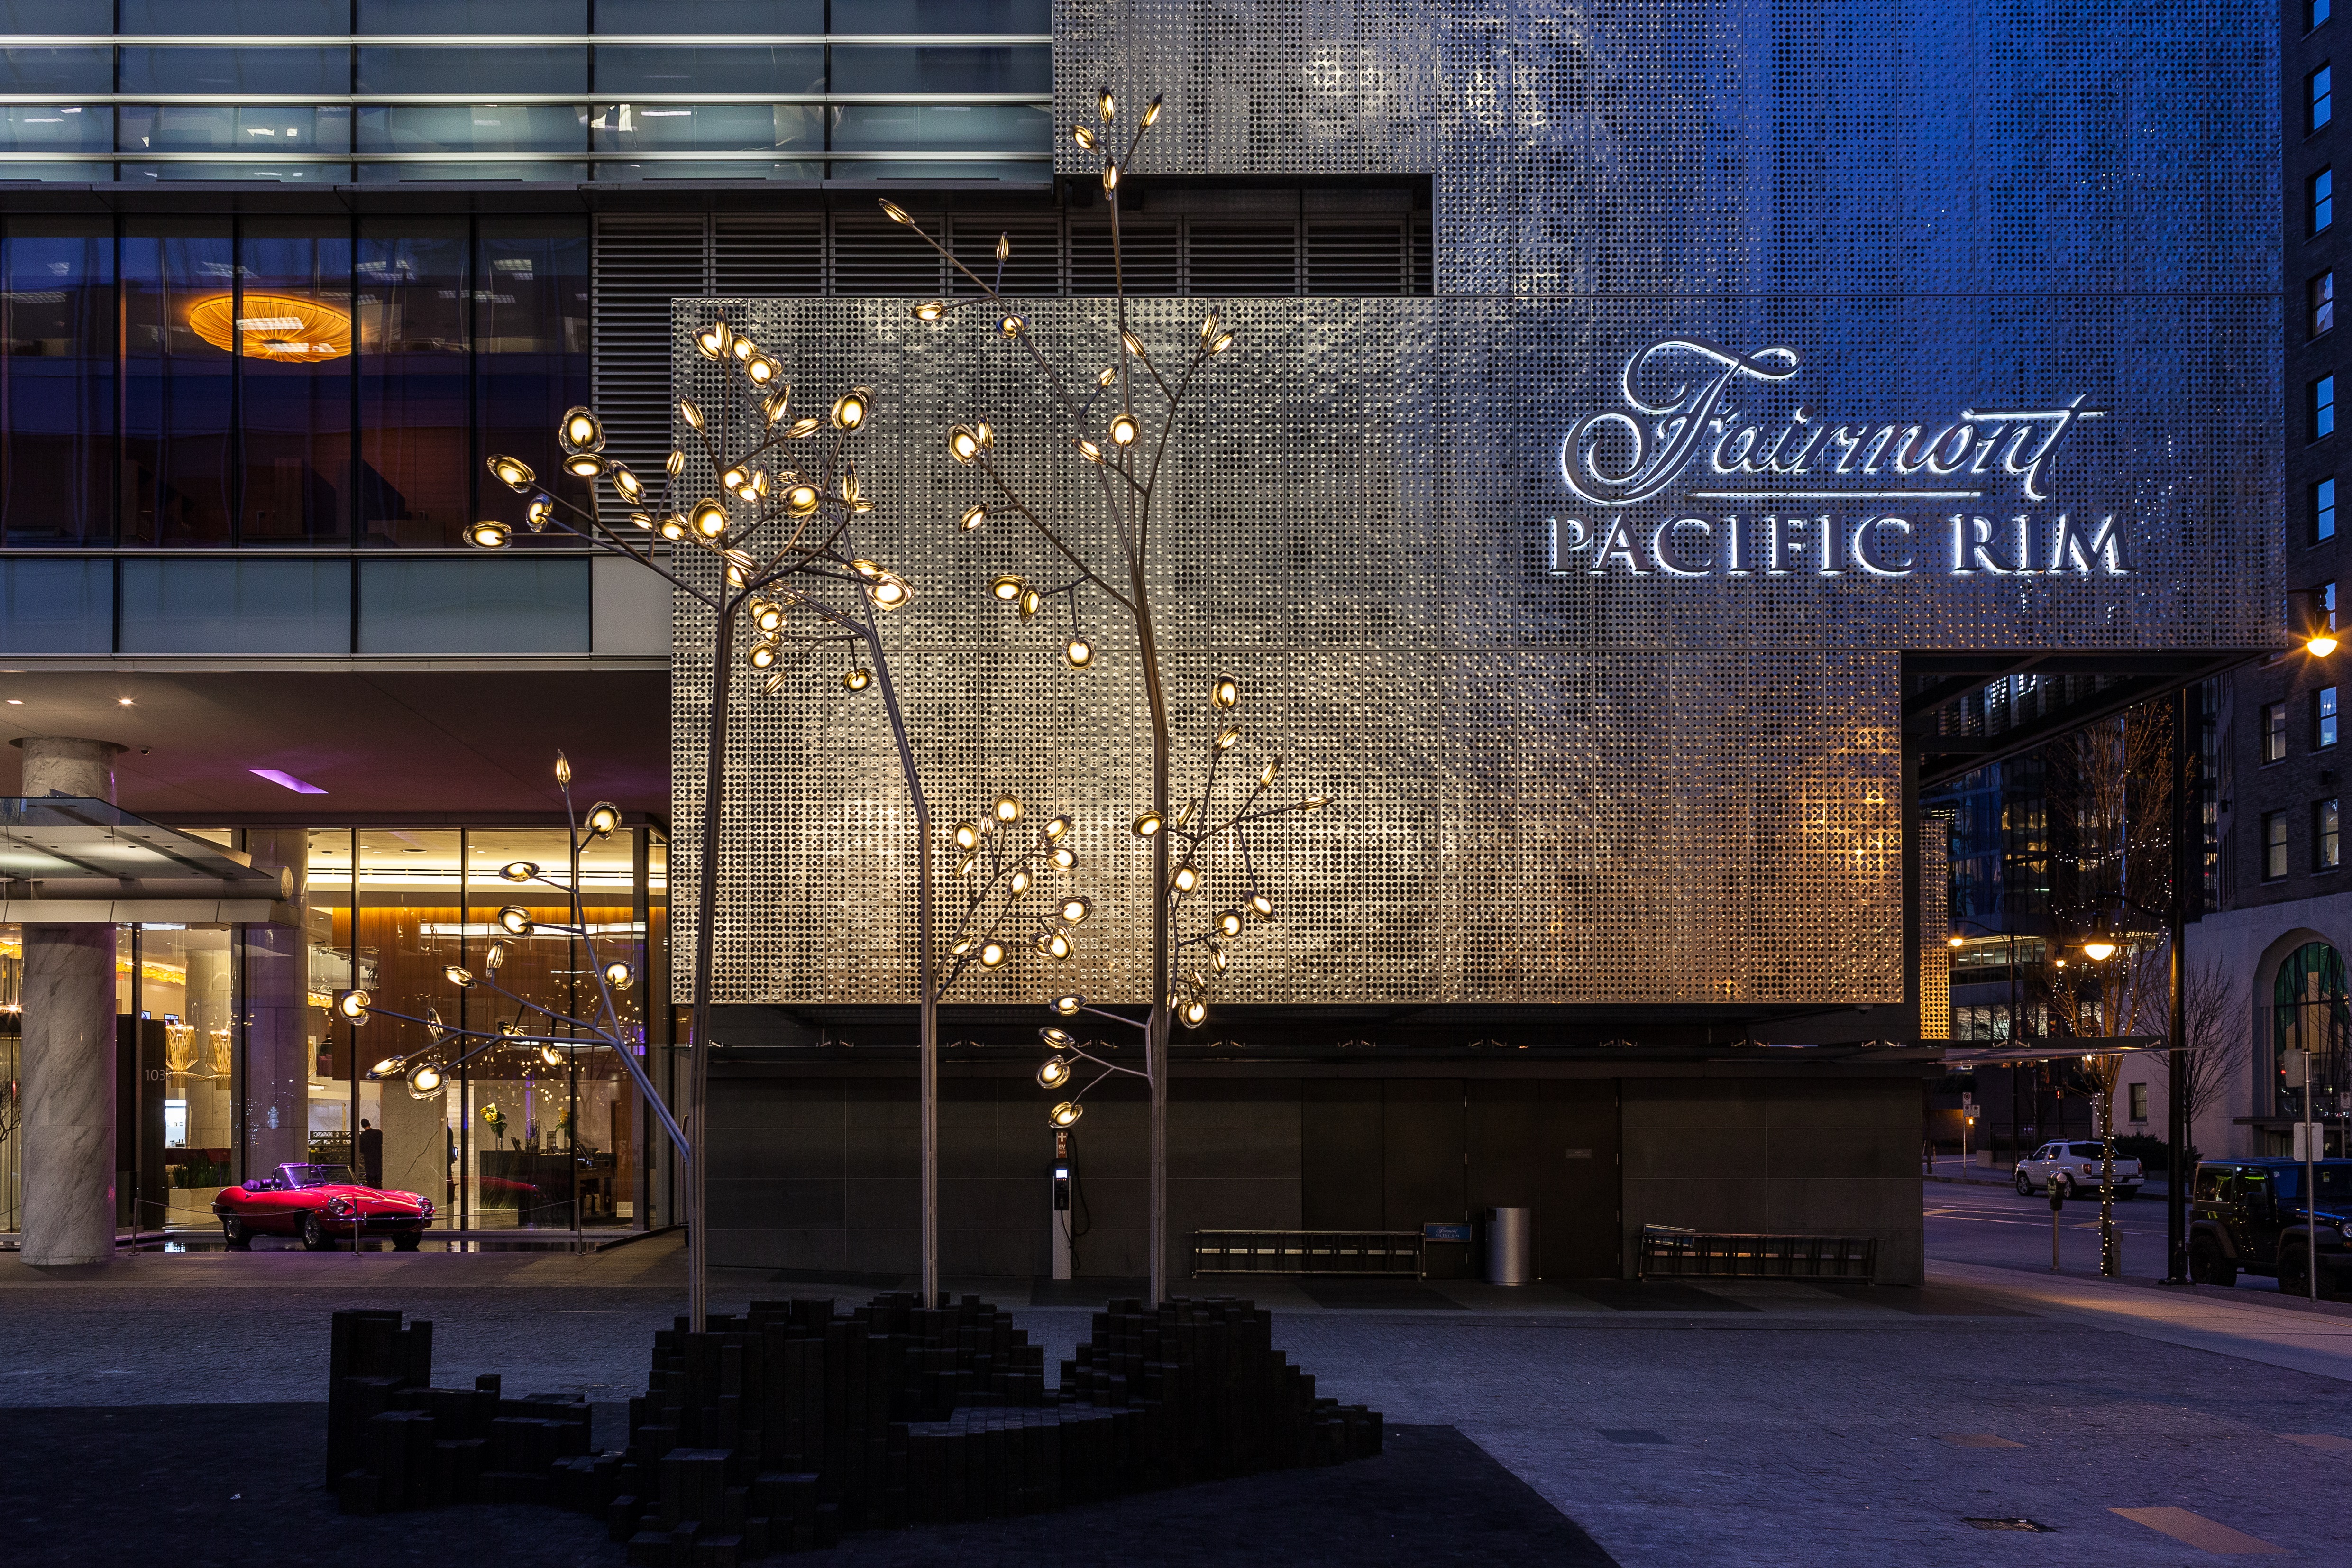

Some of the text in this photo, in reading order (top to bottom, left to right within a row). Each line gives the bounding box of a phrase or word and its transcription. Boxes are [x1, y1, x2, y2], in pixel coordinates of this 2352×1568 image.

[1561, 335, 2111, 505] Fairmont
[1548, 511, 2136, 577] PACIFIC RIM
[145, 1069, 174, 1081] 1038
